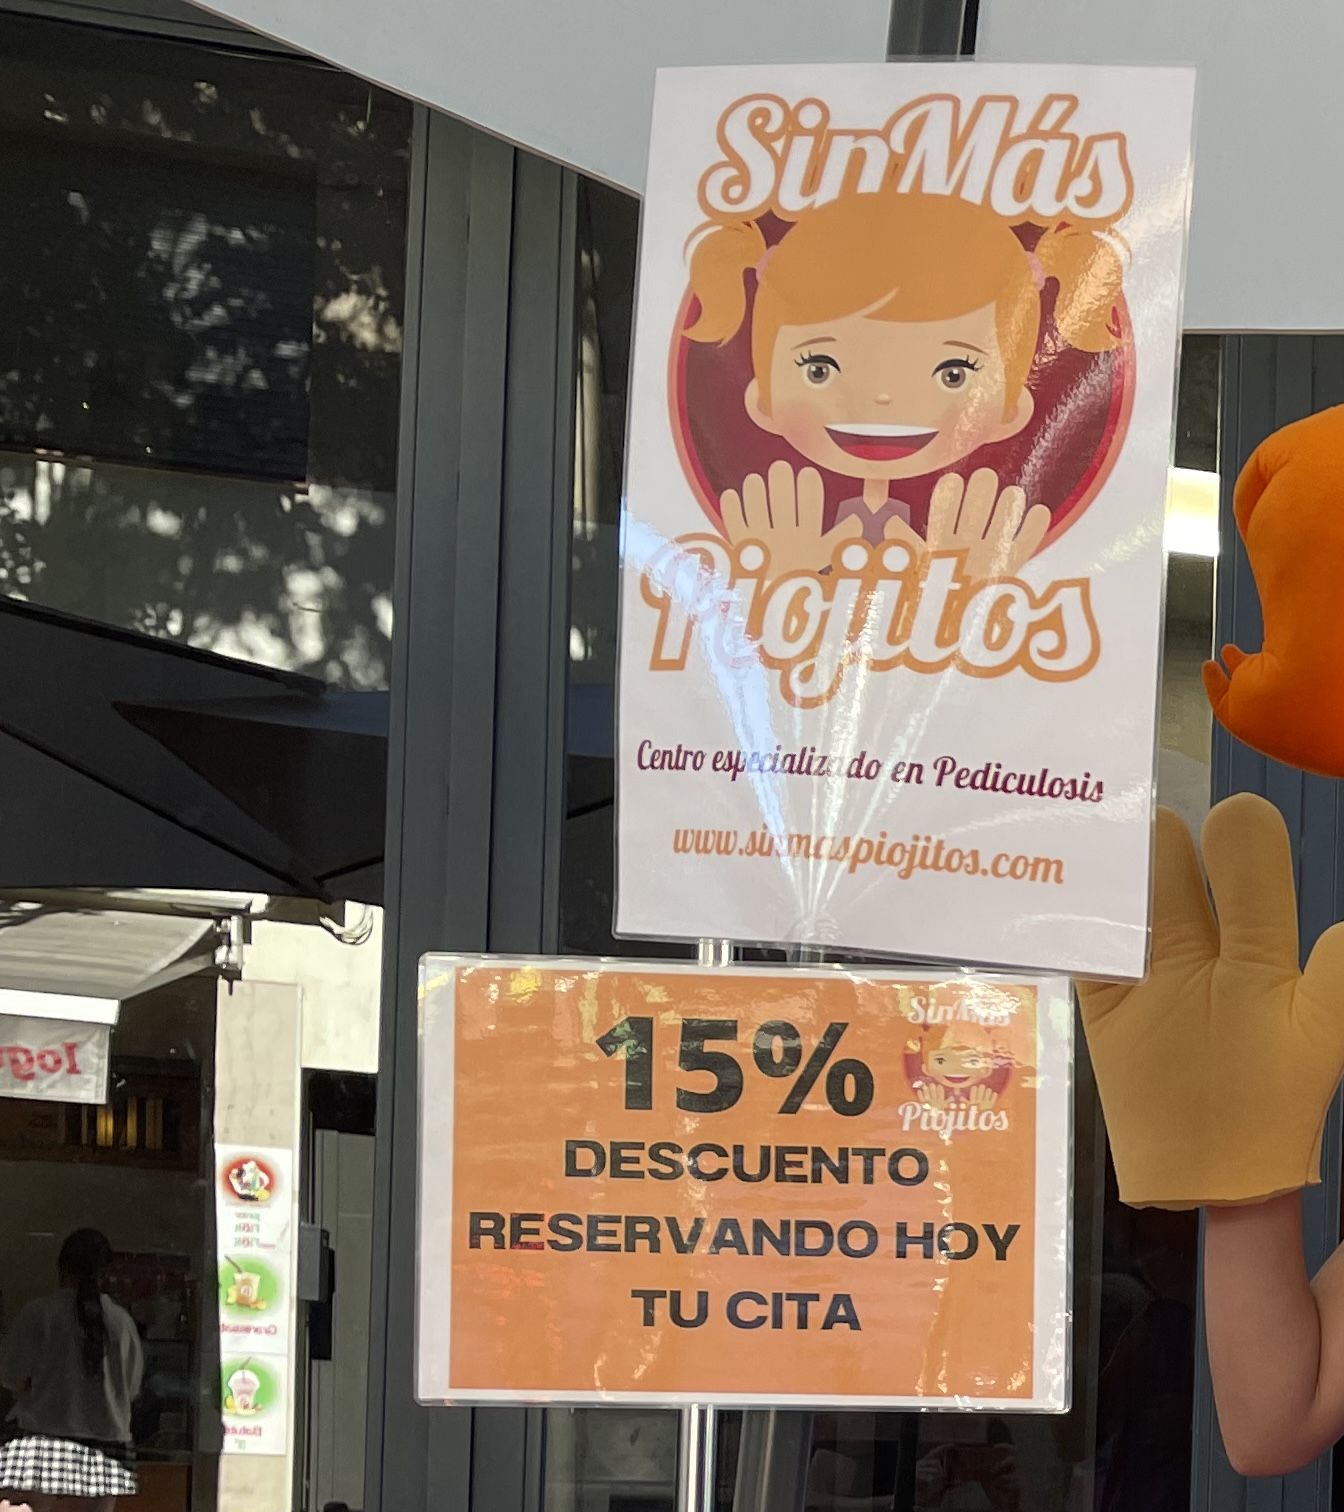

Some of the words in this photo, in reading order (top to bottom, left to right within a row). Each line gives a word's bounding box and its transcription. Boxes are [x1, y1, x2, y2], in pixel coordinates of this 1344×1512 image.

[641, 532, 1100, 708] Piojitos
[637, 740, 705, 773] Centro
[712, 744, 881, 782] especializado
[892, 757, 924, 786] en
[934, 755, 1105, 804] Pediculosis
[673, 821, 1065, 885] www.sinmaspiojitos.com
[596, 1016, 876, 1117] 15%
[898, 1101, 1009, 1141] Piojitos
[564, 1140, 929, 1187] DESCUENTO
[469, 1212, 879, 1258] RESERVANDO
[896, 1221, 1021, 1261] HOY
[632, 1289, 709, 1329] TU
[726, 1291, 862, 1331] CITA
